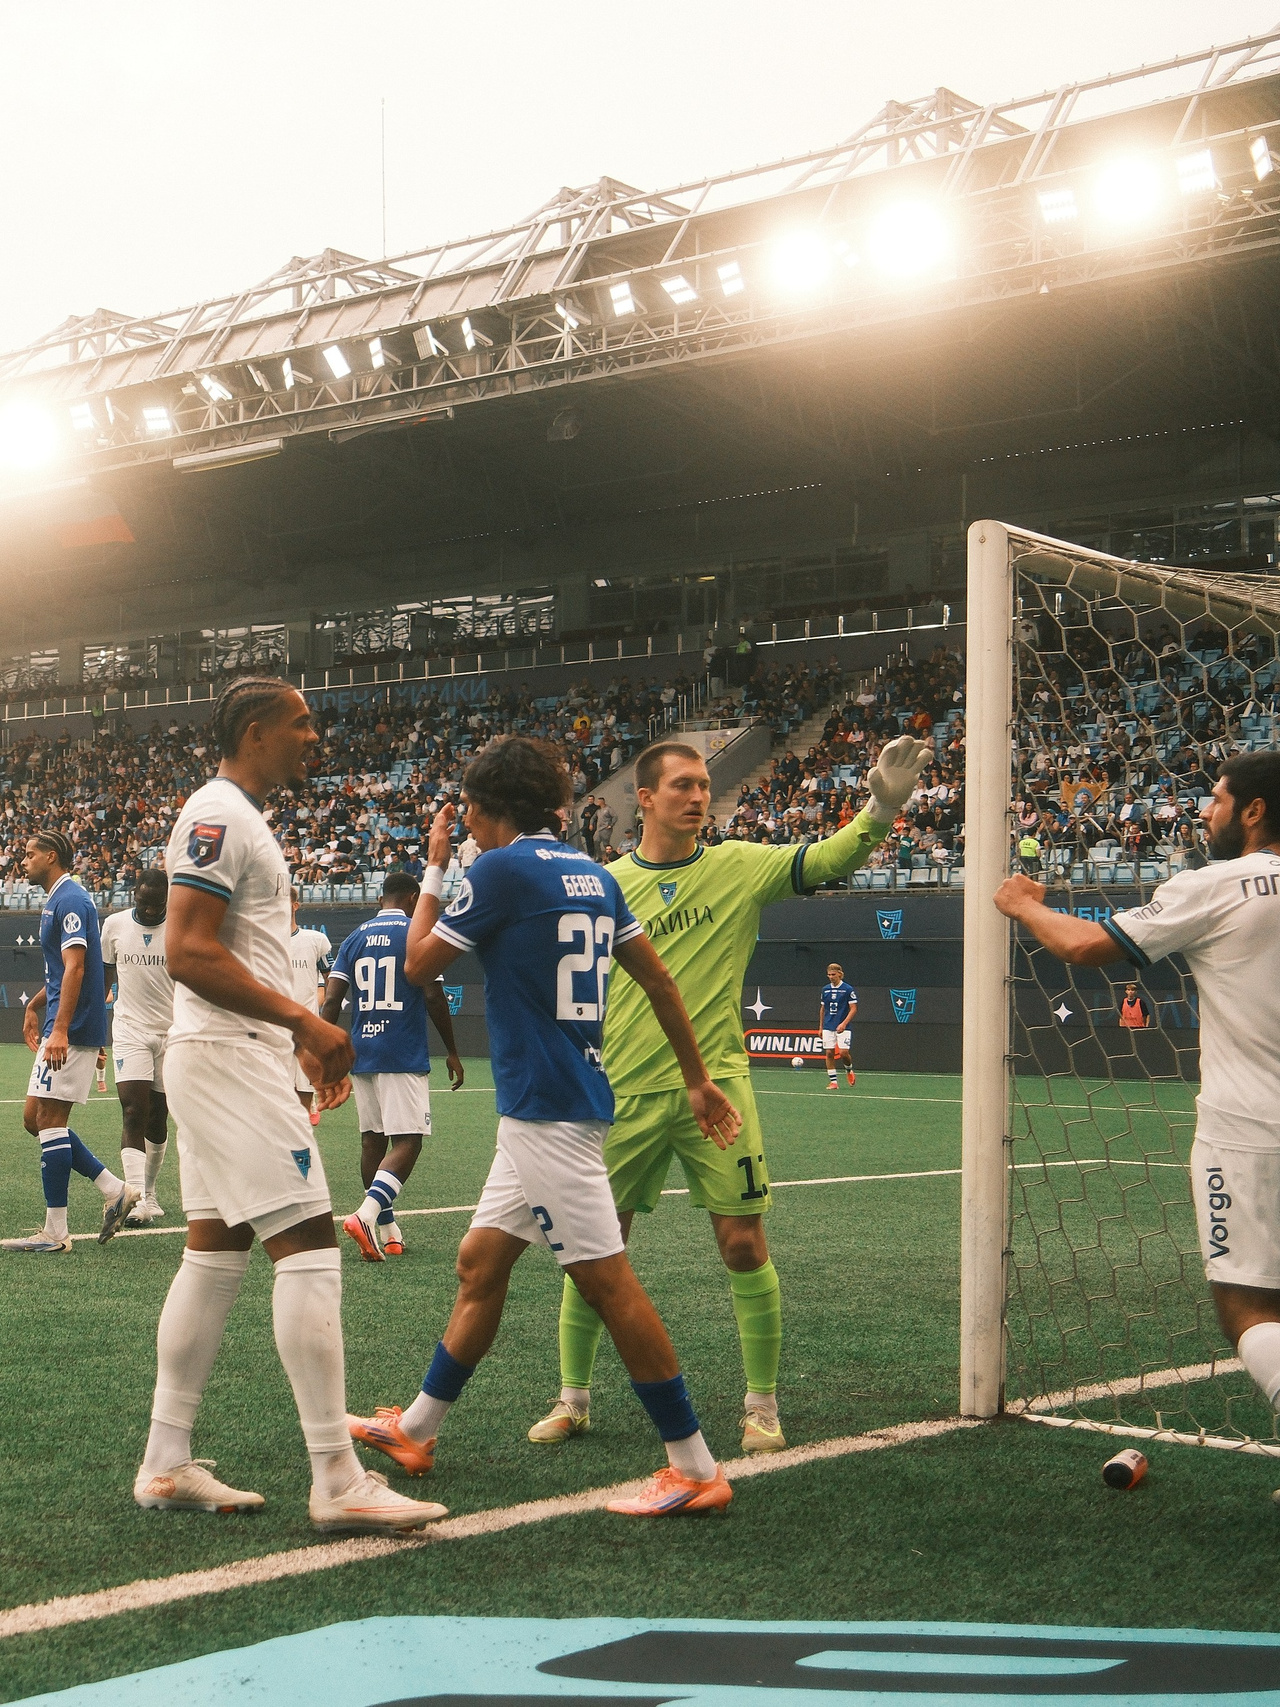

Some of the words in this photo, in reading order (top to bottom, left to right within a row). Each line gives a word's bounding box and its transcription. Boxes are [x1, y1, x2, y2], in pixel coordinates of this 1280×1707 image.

[123, 953, 168, 967] РОДИН
[365, 934, 391, 948] ХИЛЬ
[354, 956, 403, 1012] 91
[556, 913, 615, 1021] 22
[750, 1035, 823, 1053] WINLINE
[737, 1154, 768, 1201] 1
[1206, 1167, 1232, 1260] Vorgol
